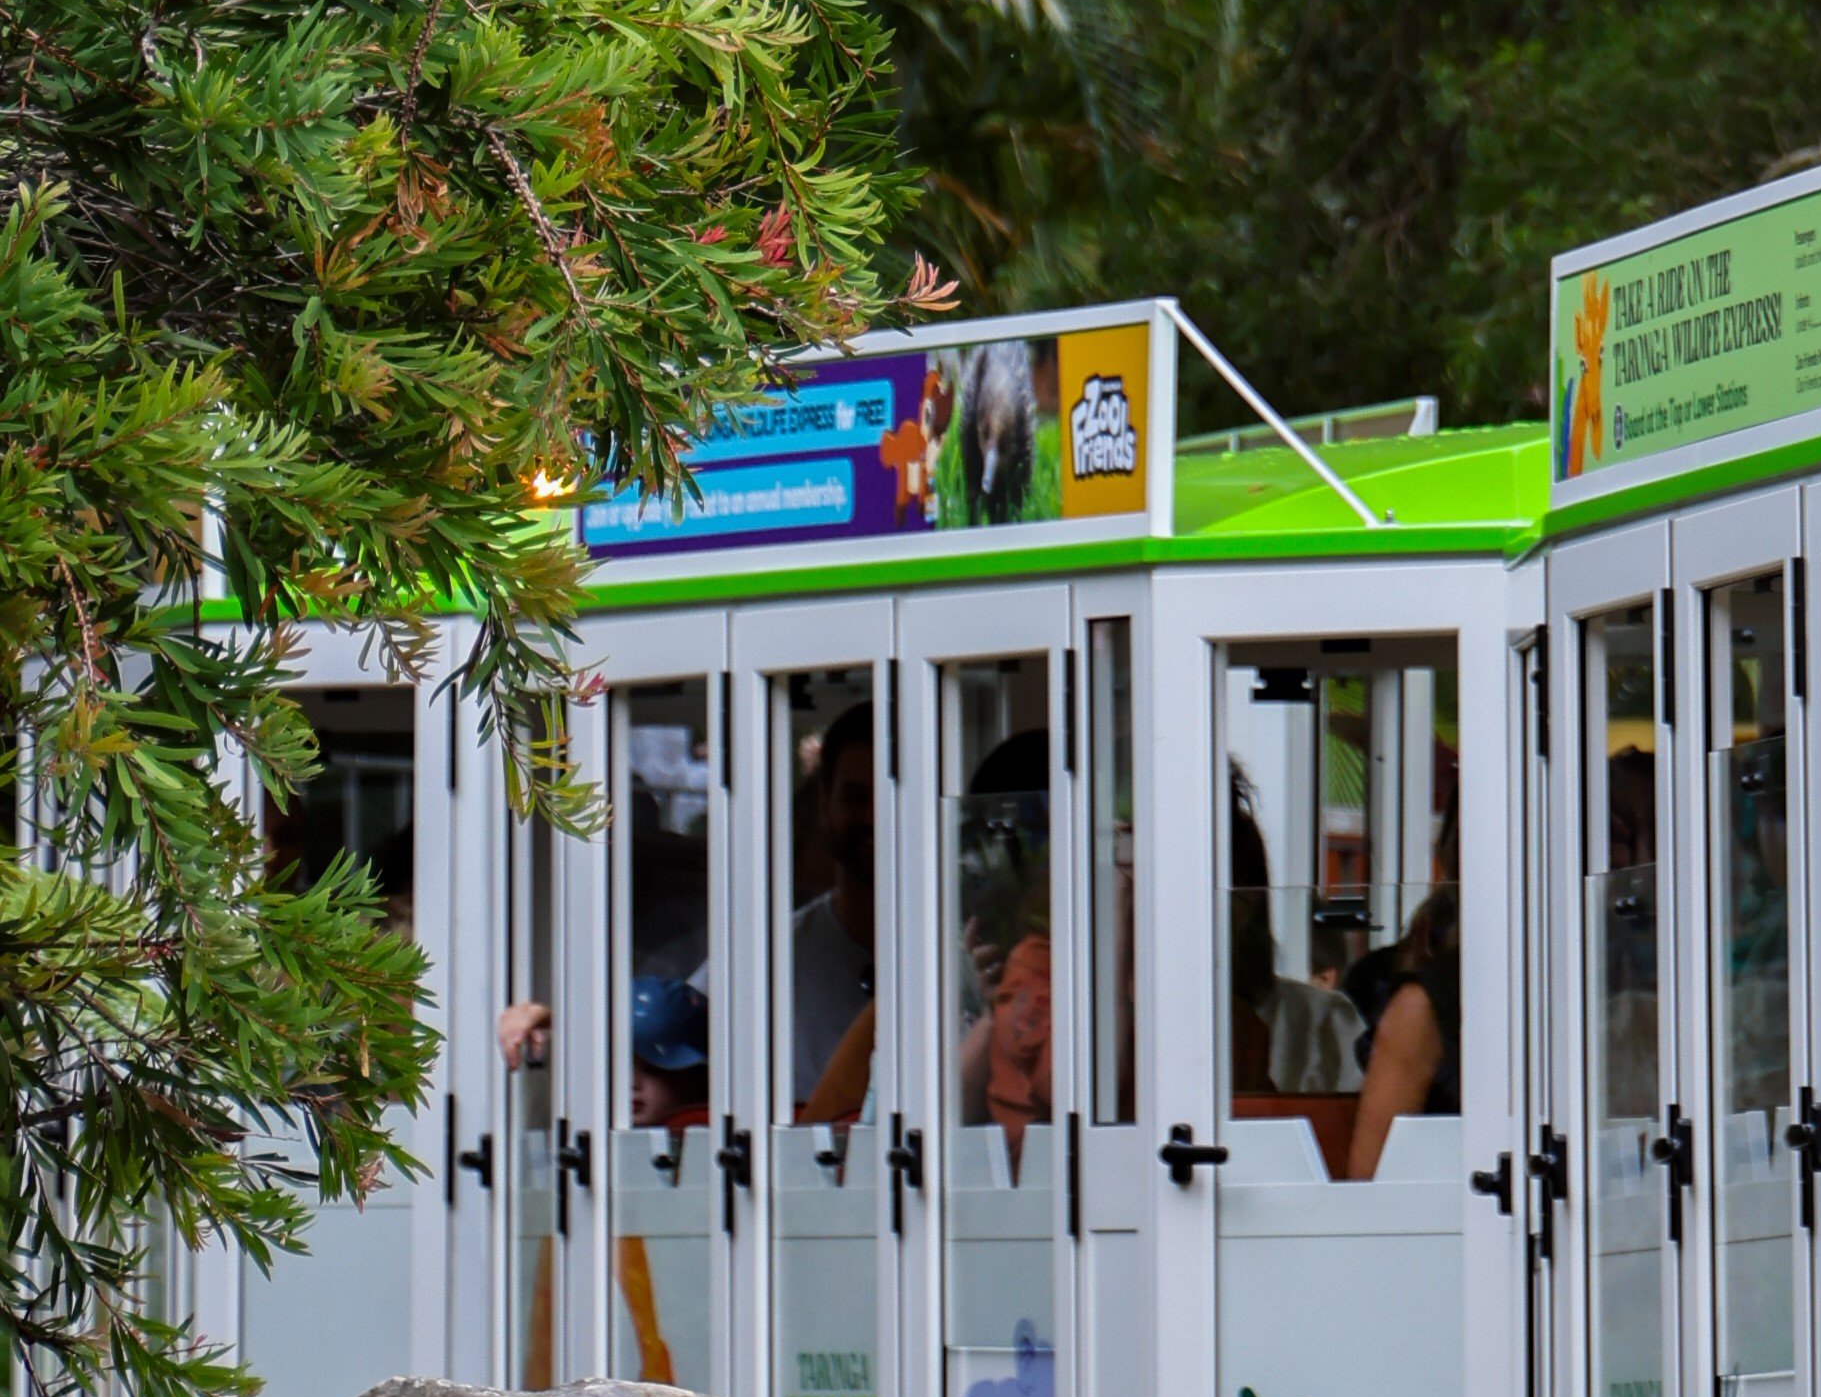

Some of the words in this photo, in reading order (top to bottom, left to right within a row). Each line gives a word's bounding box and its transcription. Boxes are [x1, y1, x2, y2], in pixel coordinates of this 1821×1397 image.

[1613, 279, 1643, 331] TAKE
[1645, 275, 1654, 321] A
[1657, 265, 1685, 317] RIDE
[1687, 258, 1704, 307] ON
[1706, 249, 1731, 300] THE
[1613, 327, 1669, 387] TARONGA
[1084, 378, 1122, 436] Zoo
[797, 1352, 870, 1390] TARONGA
